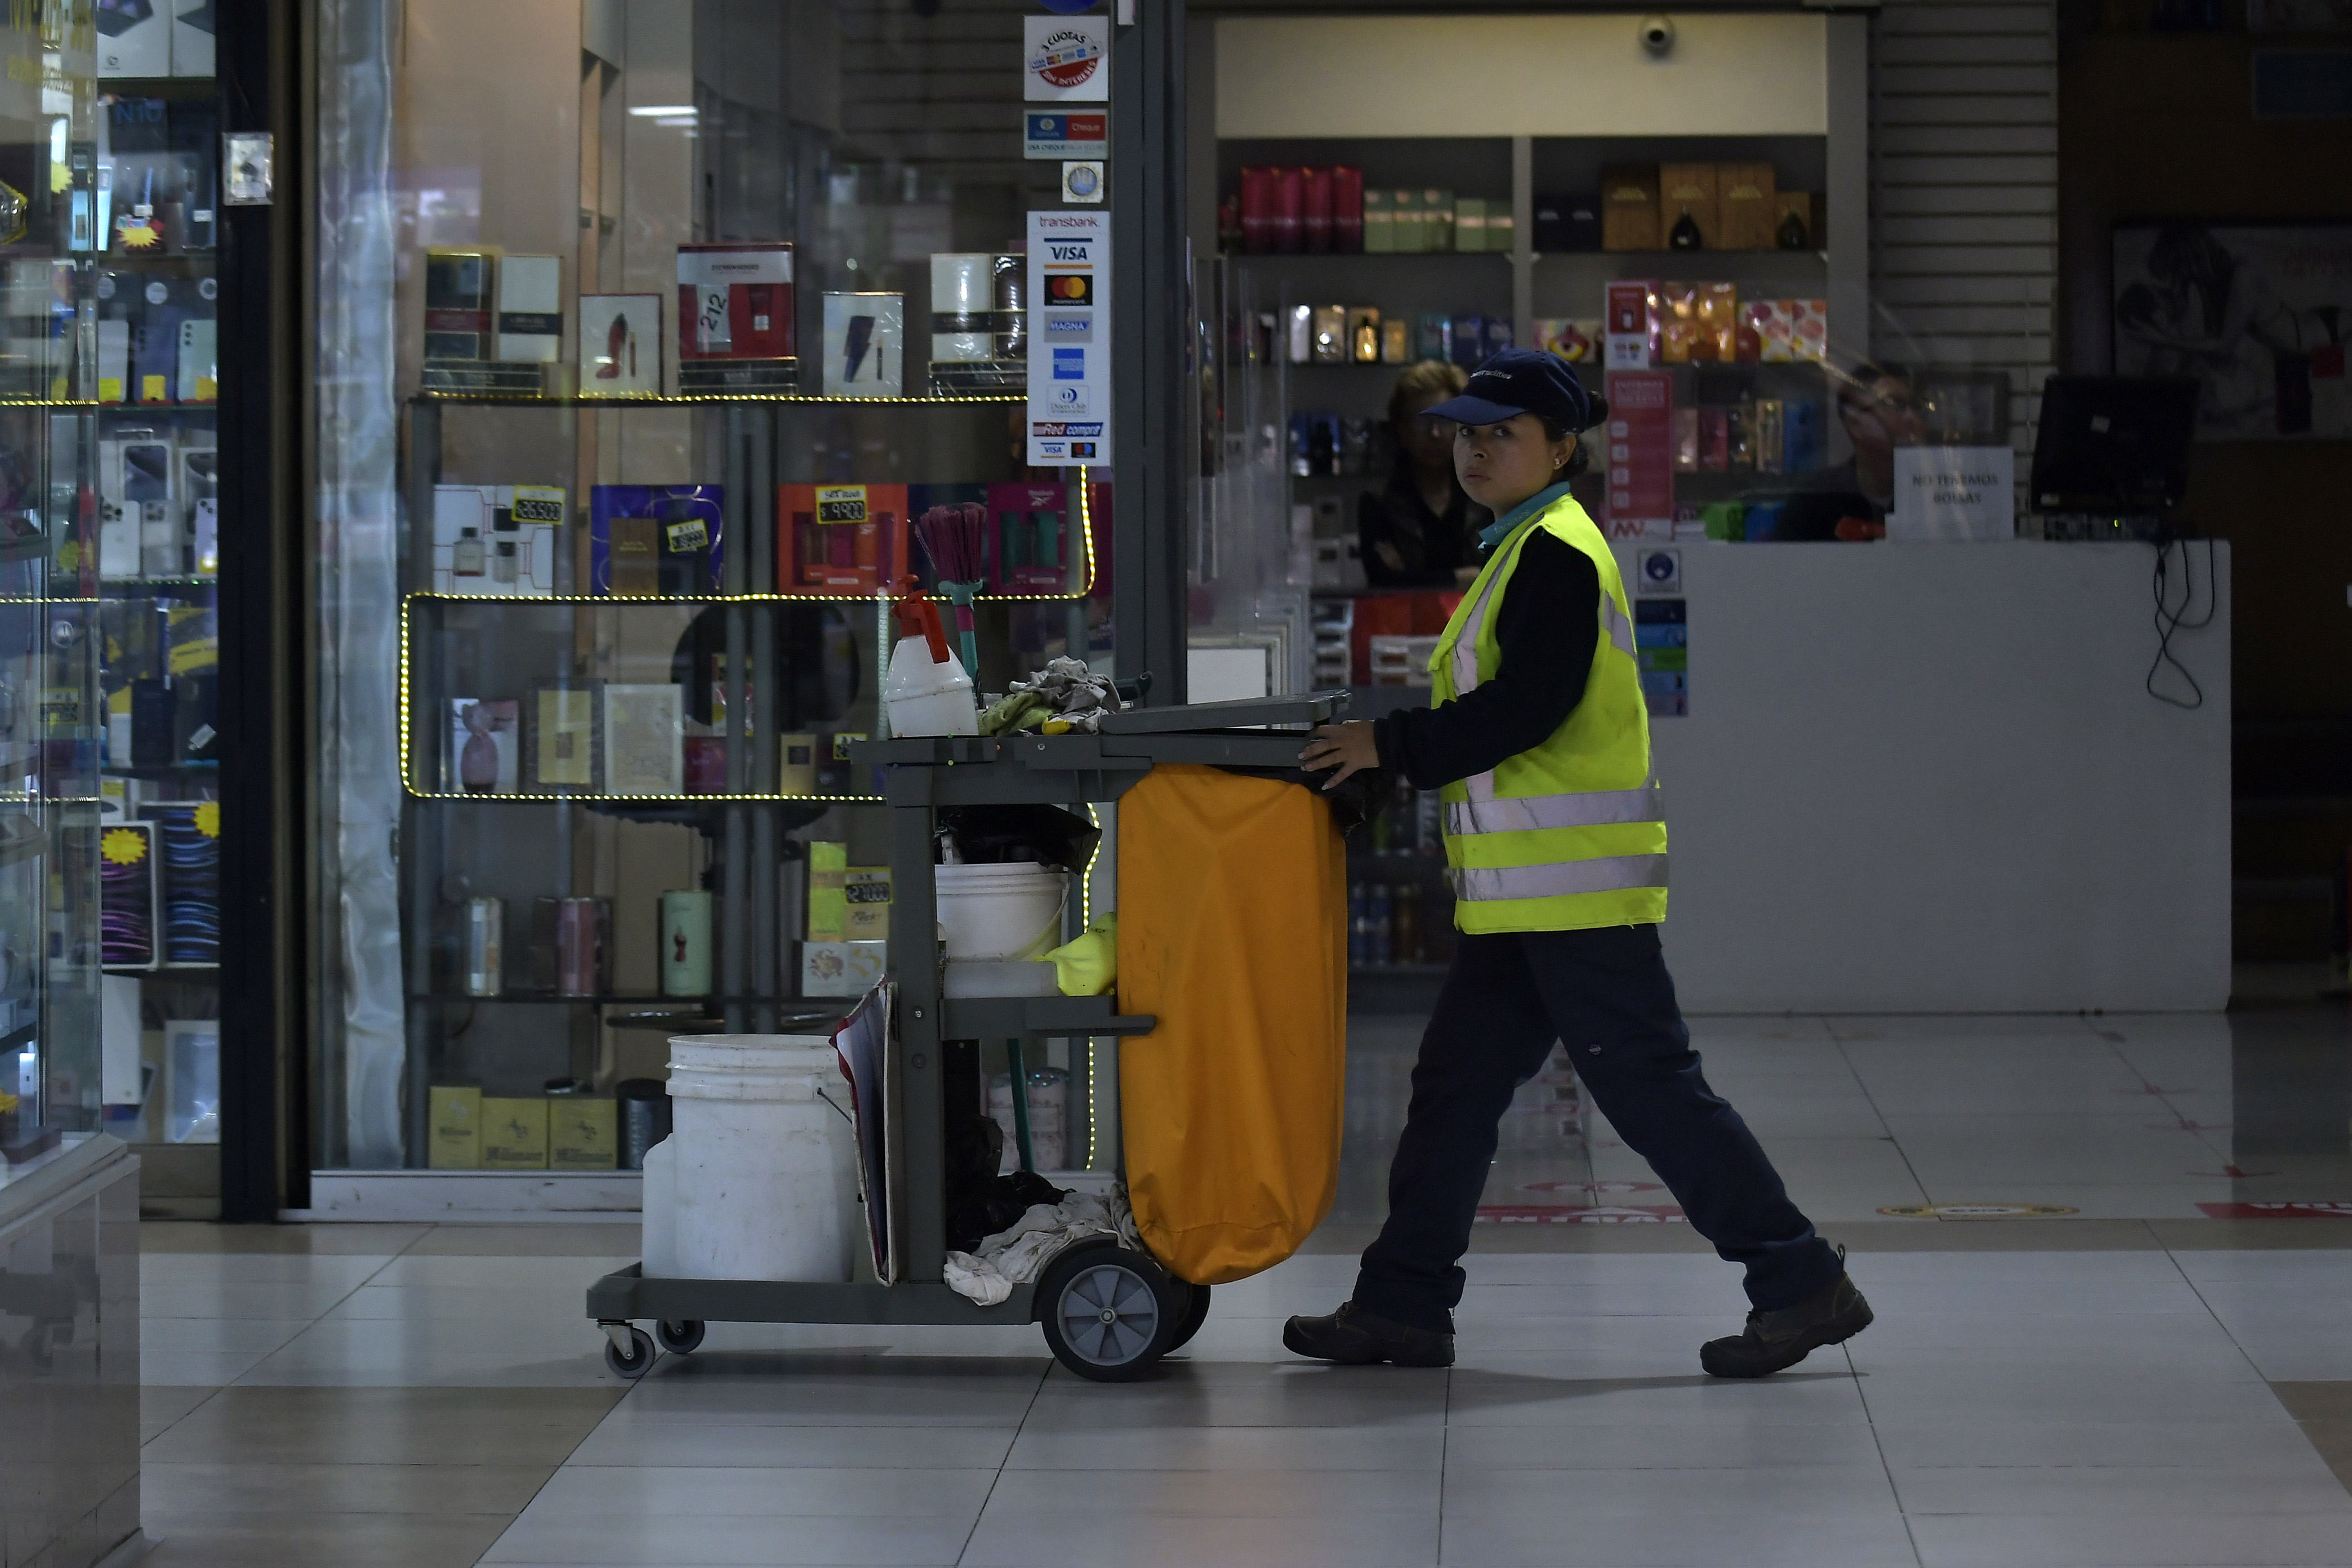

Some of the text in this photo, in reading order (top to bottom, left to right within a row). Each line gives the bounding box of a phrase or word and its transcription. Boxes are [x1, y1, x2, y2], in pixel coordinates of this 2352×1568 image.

[1048, 32, 1086, 46] CUOTAS
[1072, 123, 1101, 132] Cheque
[1050, 247, 1088, 260] VISA
[700, 294, 727, 332] 212
[1049, 322, 1085, 331] MAGNA
[1044, 423, 1101, 436] Red compra
